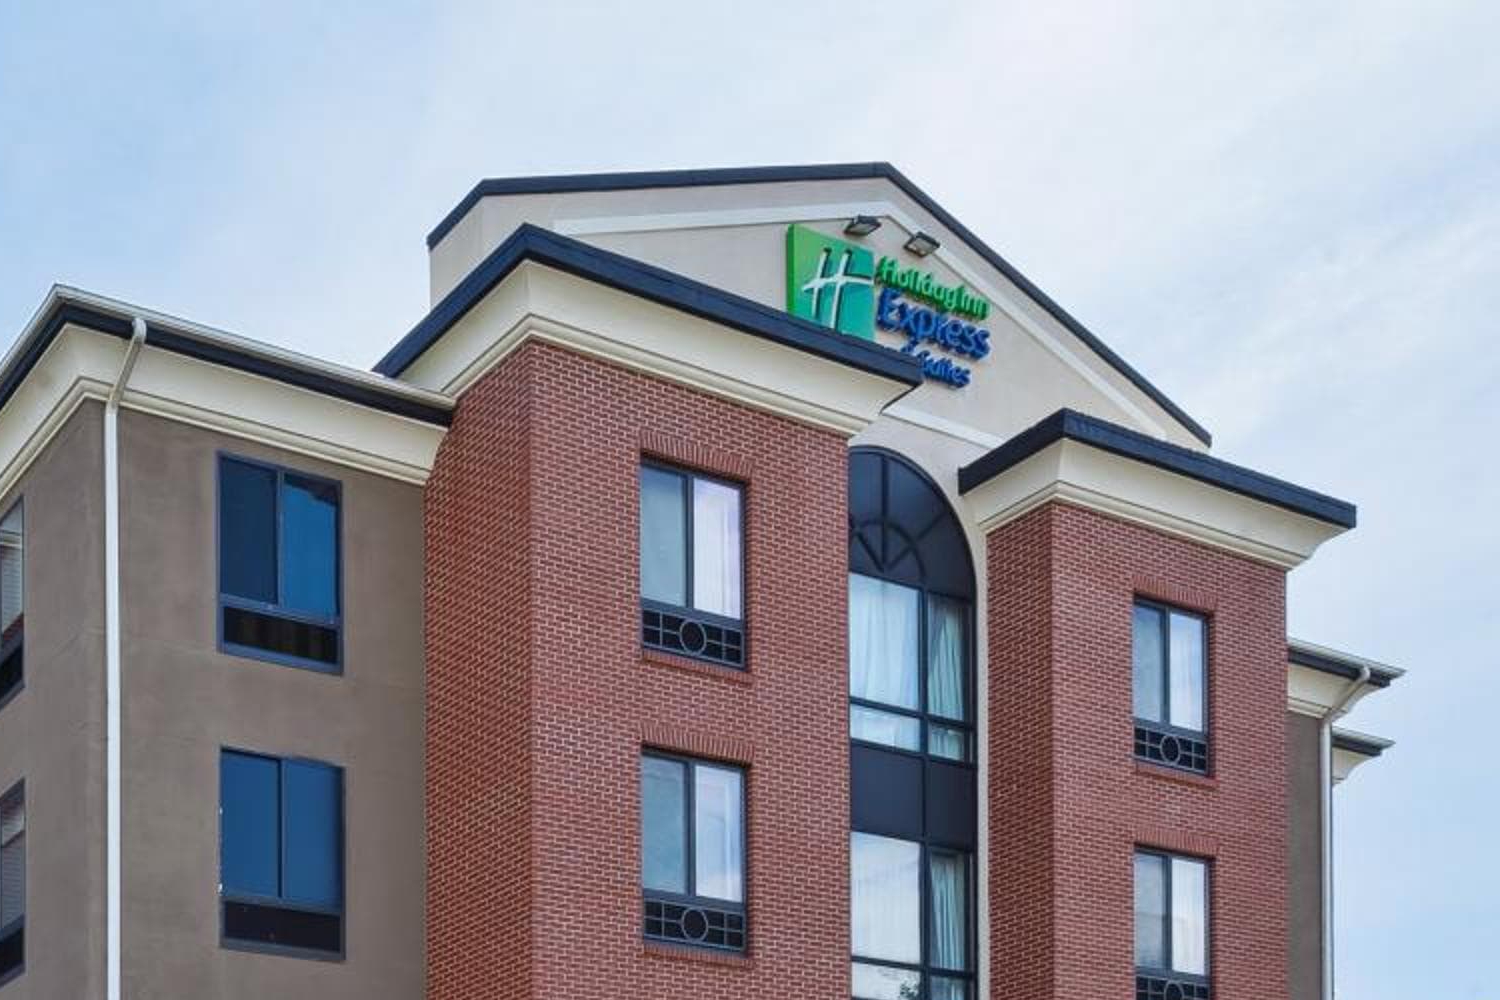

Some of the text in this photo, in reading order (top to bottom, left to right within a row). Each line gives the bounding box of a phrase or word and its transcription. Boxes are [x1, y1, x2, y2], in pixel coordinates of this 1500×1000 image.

[876, 256, 990, 321] Holiday Inn
[877, 287, 991, 359] Express
